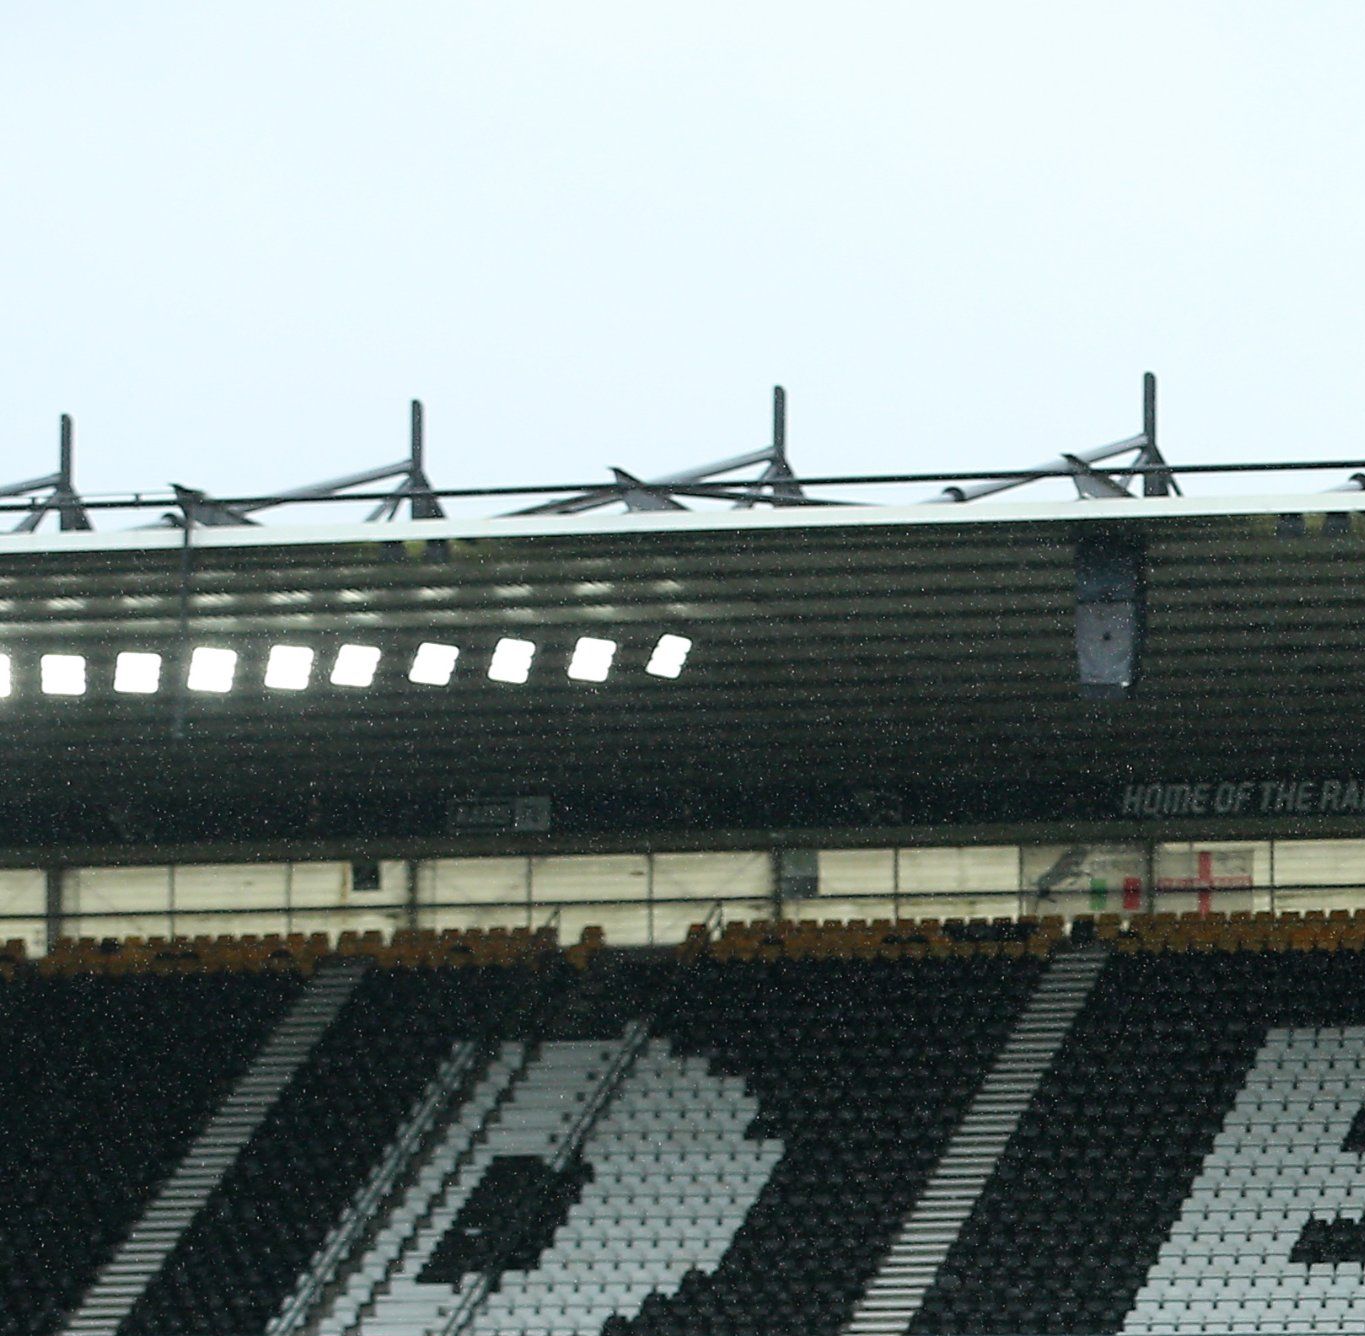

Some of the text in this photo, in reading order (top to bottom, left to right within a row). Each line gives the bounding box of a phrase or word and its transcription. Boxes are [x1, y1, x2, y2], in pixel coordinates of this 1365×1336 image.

[1122, 783, 1211, 814] HOME
[1215, 782, 1256, 812] OF
[1258, 780, 1319, 811] THE
